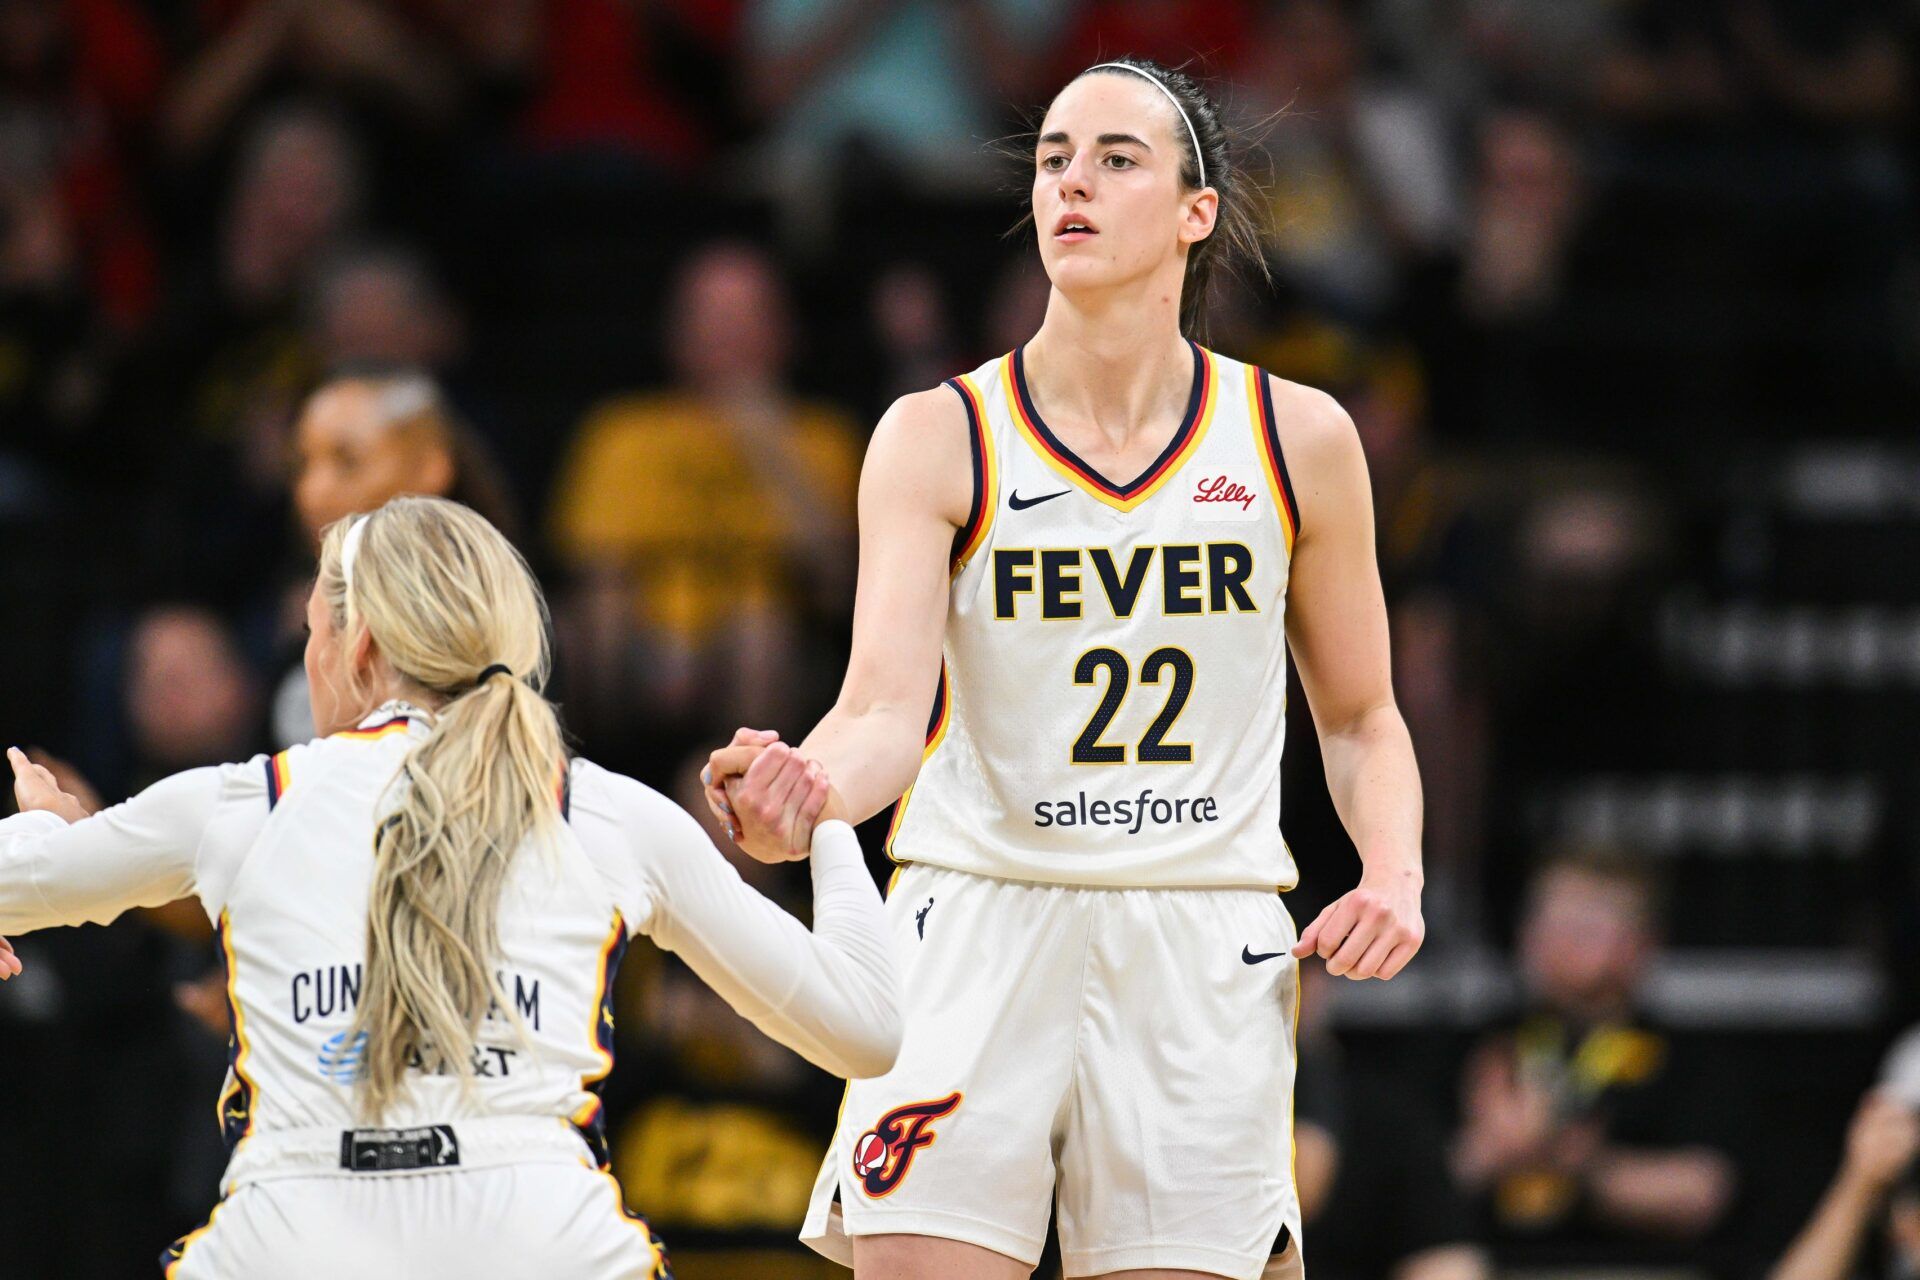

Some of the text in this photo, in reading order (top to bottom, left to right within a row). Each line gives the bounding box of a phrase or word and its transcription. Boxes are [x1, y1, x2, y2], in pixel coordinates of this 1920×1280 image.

[1193, 475, 1258, 511] Lilly
[992, 540, 1260, 621] FEVER
[1070, 645, 1197, 765] 22
[1034, 789, 1219, 835] salesforce
